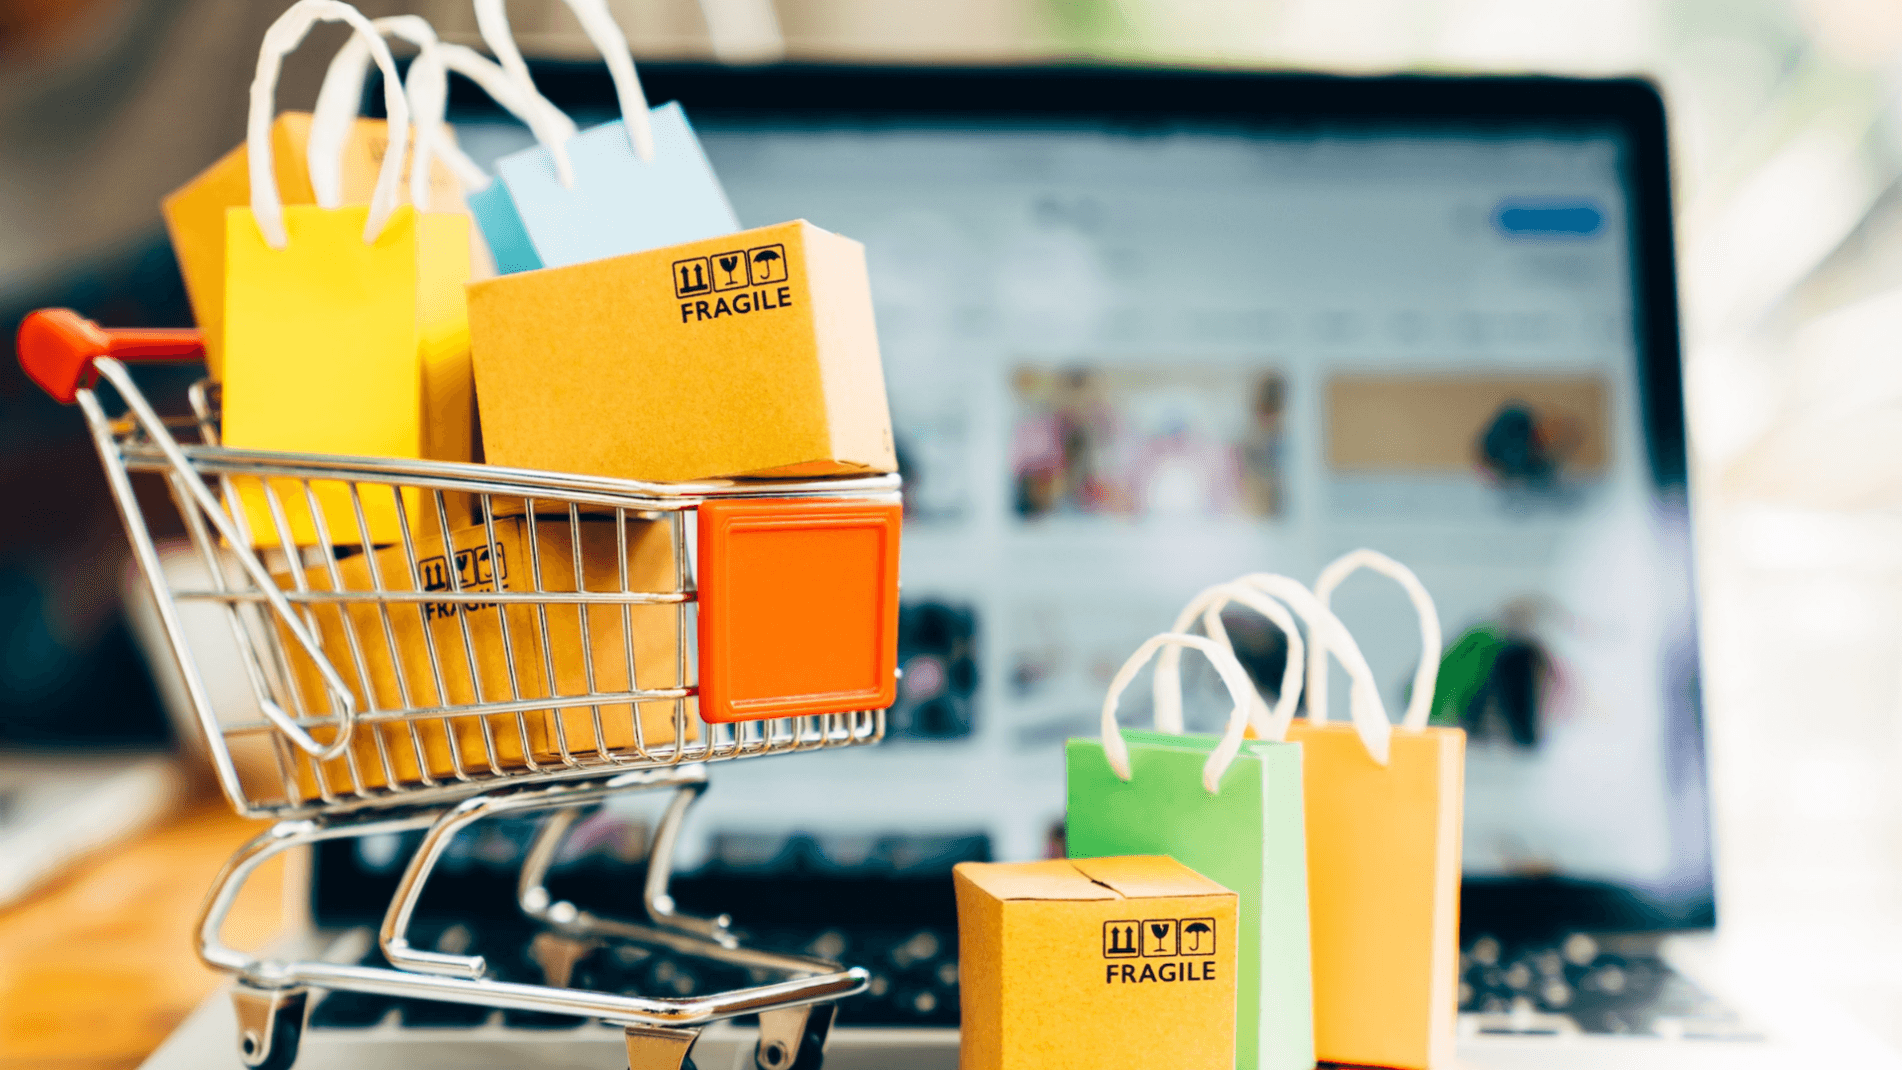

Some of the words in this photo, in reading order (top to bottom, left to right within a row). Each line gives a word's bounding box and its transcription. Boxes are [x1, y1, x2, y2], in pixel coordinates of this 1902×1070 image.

[681, 286, 792, 323] FRAGILE
[424, 584, 509, 621] FRIL
[1106, 961, 1216, 984] FRAGILE
